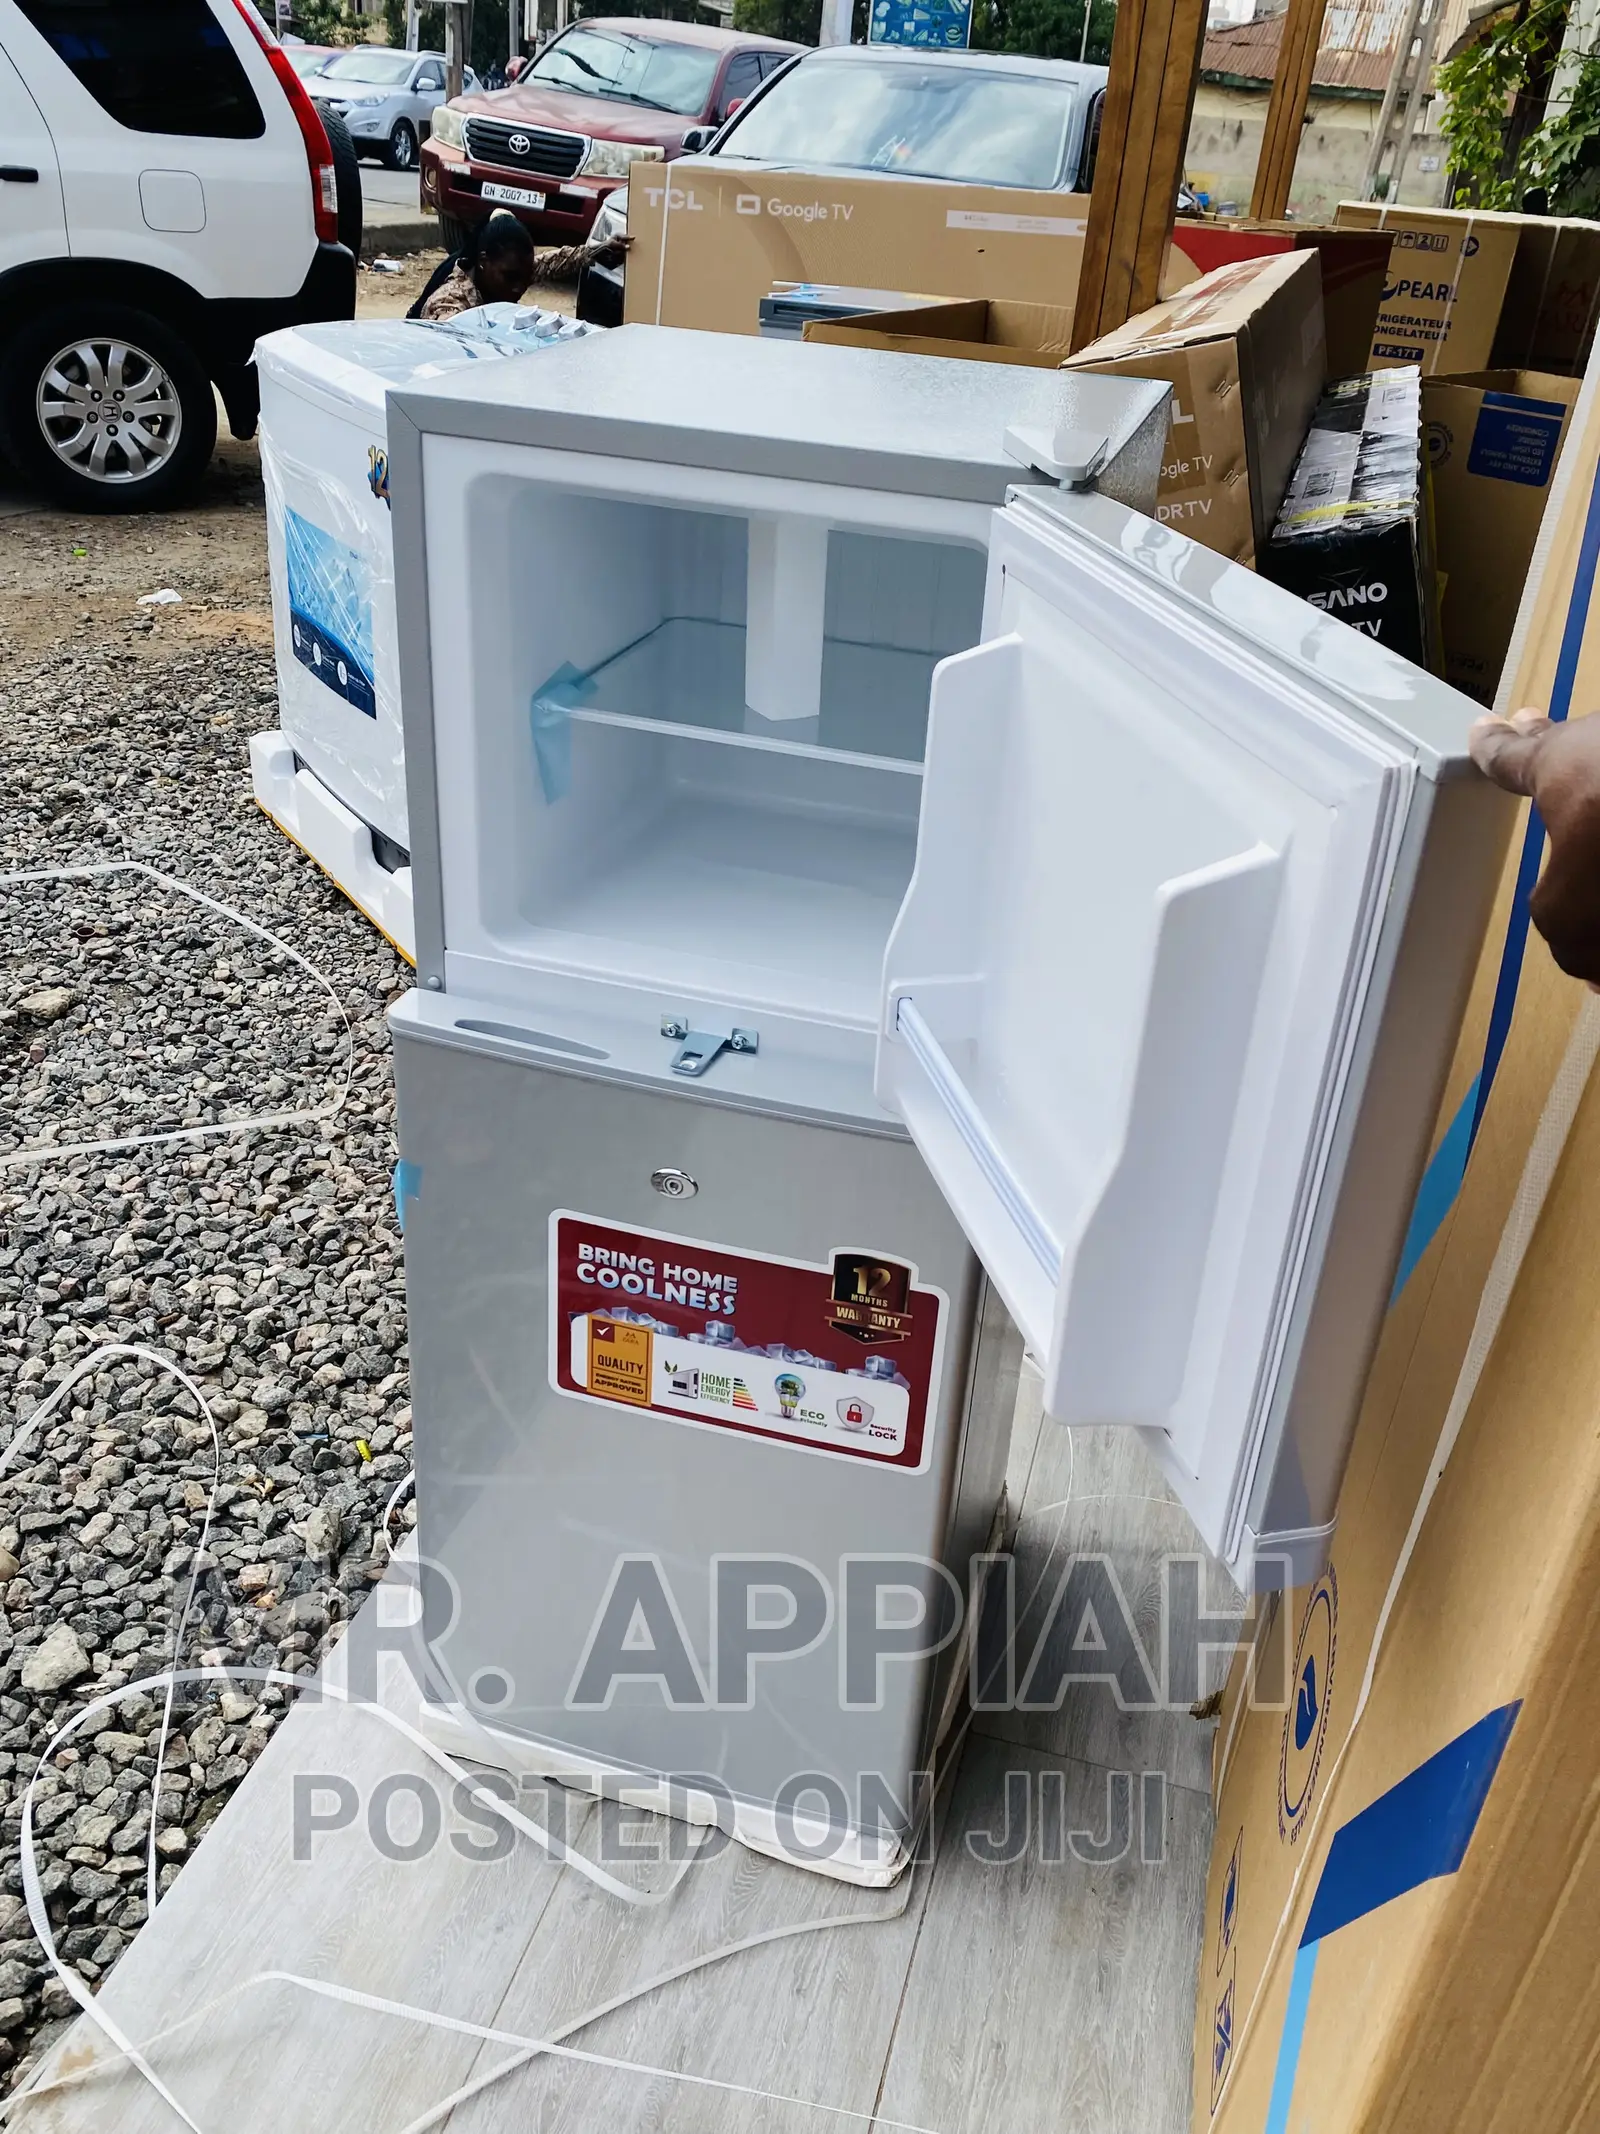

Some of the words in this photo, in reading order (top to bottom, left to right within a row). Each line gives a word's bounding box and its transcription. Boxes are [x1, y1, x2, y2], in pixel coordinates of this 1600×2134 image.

[484, 184, 496, 197] GN
[643, 187, 703, 211] TCL
[767, 198, 828, 222] Google
[832, 203, 854, 220] TV
[1373, 324, 1448, 341] ONGELATEUR
[1378, 344, 1419, 360] PF-17T
[1171, 399, 1194, 425] L
[1161, 458, 1189, 479] ogle
[1192, 454, 1213, 471] TV
[1306, 582, 1388, 610] SANO
[1351, 618, 1383, 637] TV
[578, 1243, 656, 1276] BRING
[663, 1262, 739, 1294] HOME
[576, 1262, 736, 1316] COOLNESS
[853, 1266, 892, 1298] 12
[851, 1293, 889, 1308] MONTHS
[836, 1306, 901, 1329] WAANTY
[597, 1354, 644, 1375] QUALITY
[594, 1378, 645, 1395] APPROVED
[700, 1383, 731, 1398] ENERGY
[701, 1372, 732, 1390] HOME
[800, 1408, 825, 1421] ECO
[868, 1429, 898, 1441] LOCK
[870, 1423, 897, 1434] Security
